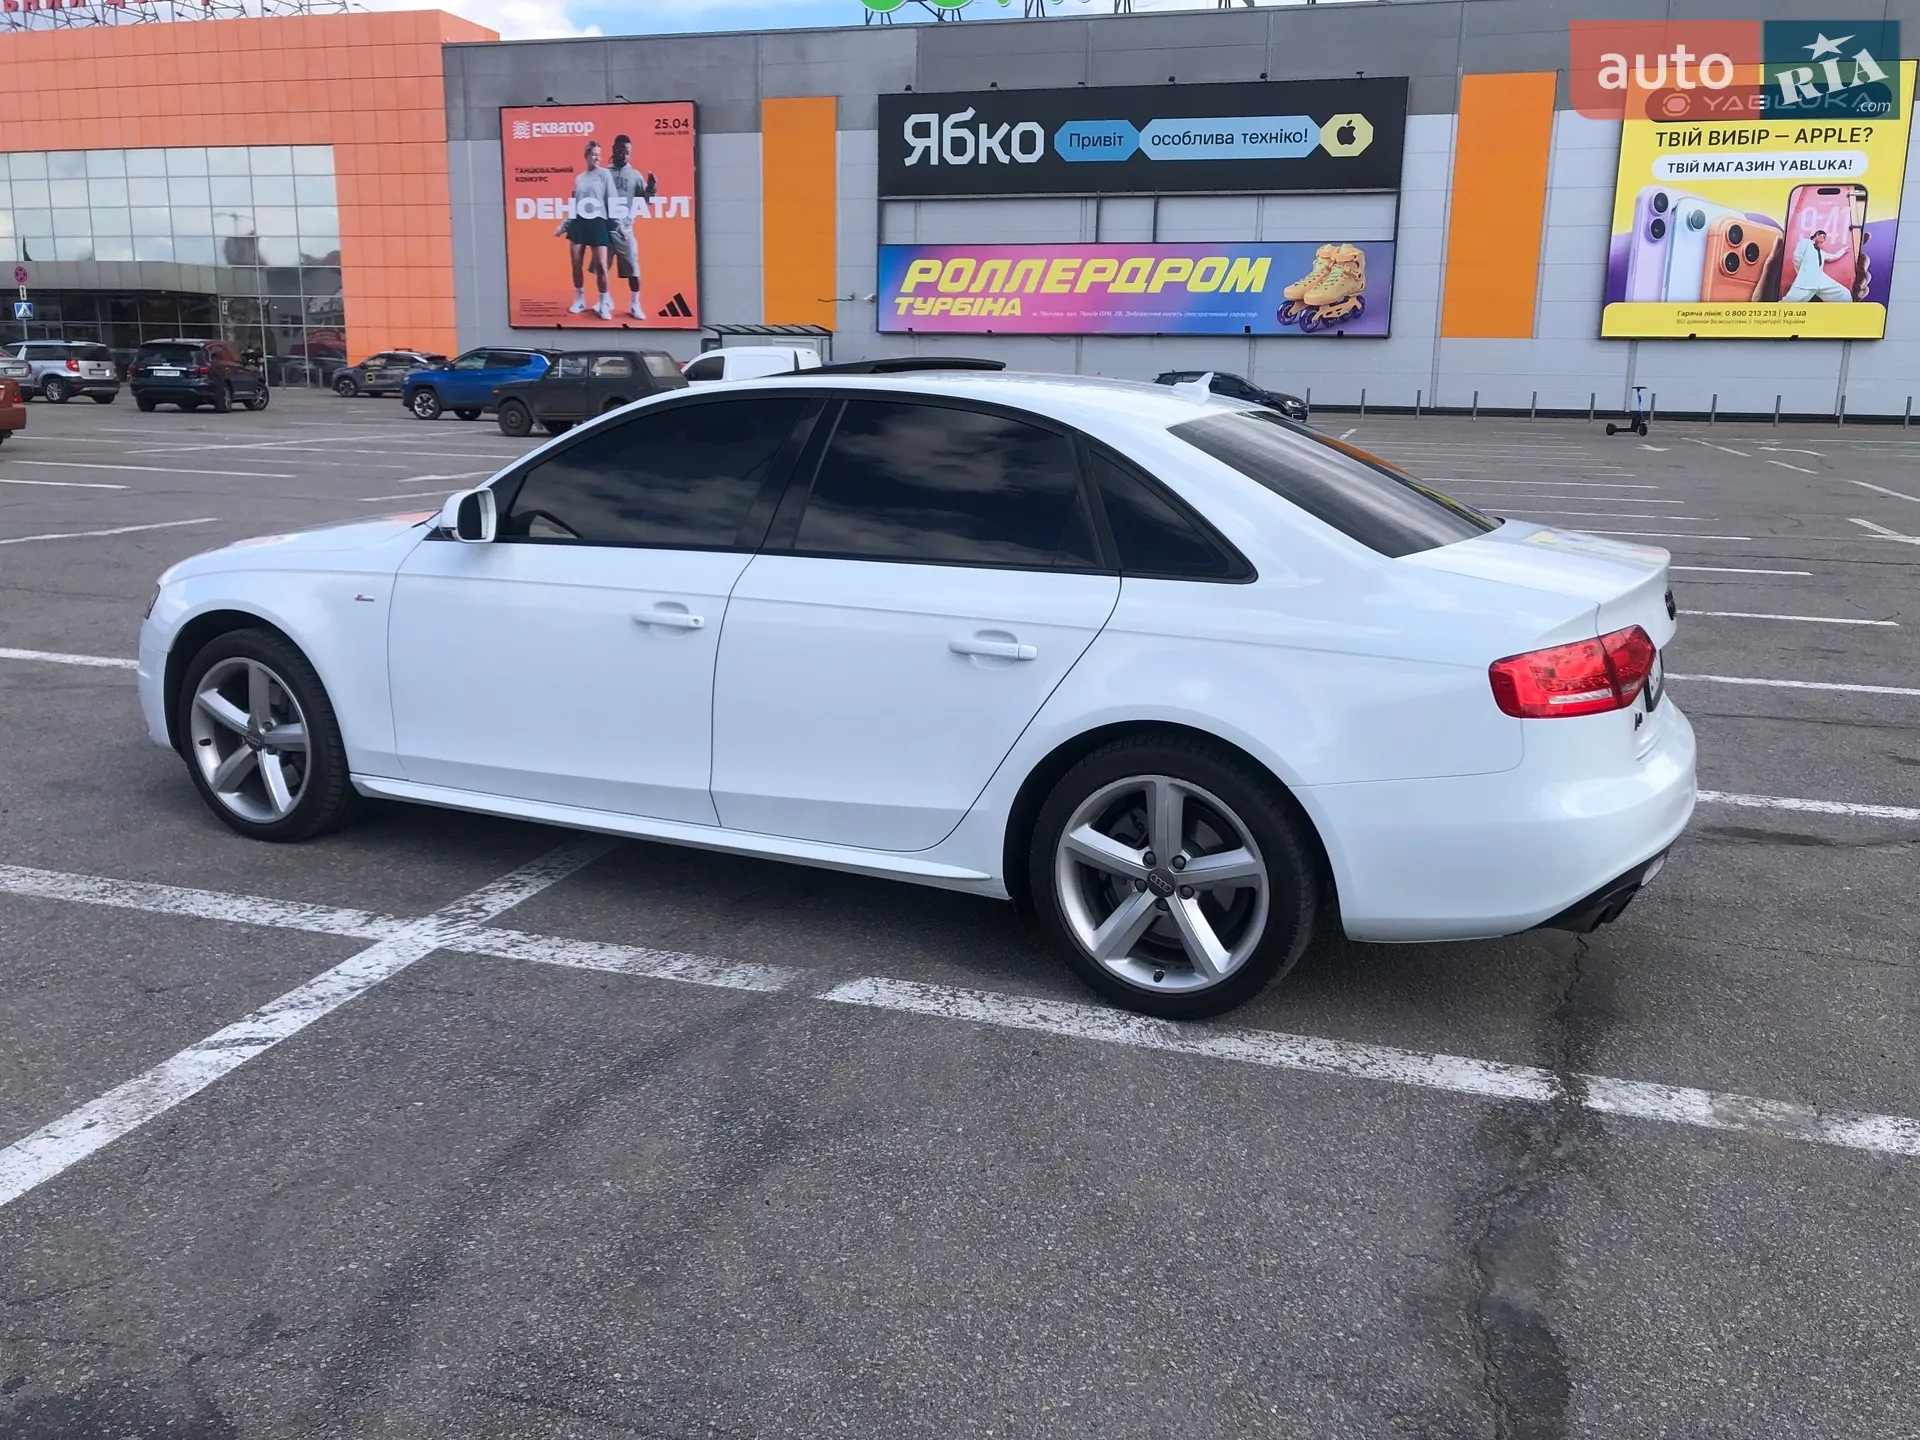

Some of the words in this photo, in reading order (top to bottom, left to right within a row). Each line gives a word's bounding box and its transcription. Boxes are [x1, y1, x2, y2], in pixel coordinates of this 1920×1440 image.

[532, 121, 594, 137] Екватор
[655, 118, 689, 129] 25.04
[903, 106, 1045, 167] Ябко
[1655, 128, 1703, 148] ТВІЙ
[1708, 129, 1770, 146] ВИБІР
[1794, 126, 1874, 145] APPLE?
[1069, 131, 1124, 150] Привіт
[1151, 130, 1235, 146] особлива
[1242, 128, 1309, 145] техніко!
[515, 166, 574, 174] ТАНЦЮВАЛЬНИЙ
[1667, 160, 1700, 174] ТВІЙ
[1702, 160, 1775, 173] МАГАЗИН
[1780, 159, 1853, 172] YABLUKA!
[608, 196, 690, 219] БАТЛ
[900, 256, 1272, 294] РОЛЛЕРДРОМ
[894, 297, 1022, 317] ТУРБІНА
[1677, 310, 1703, 318] Гаряча
[1783, 310, 1807, 318] ya.ua
